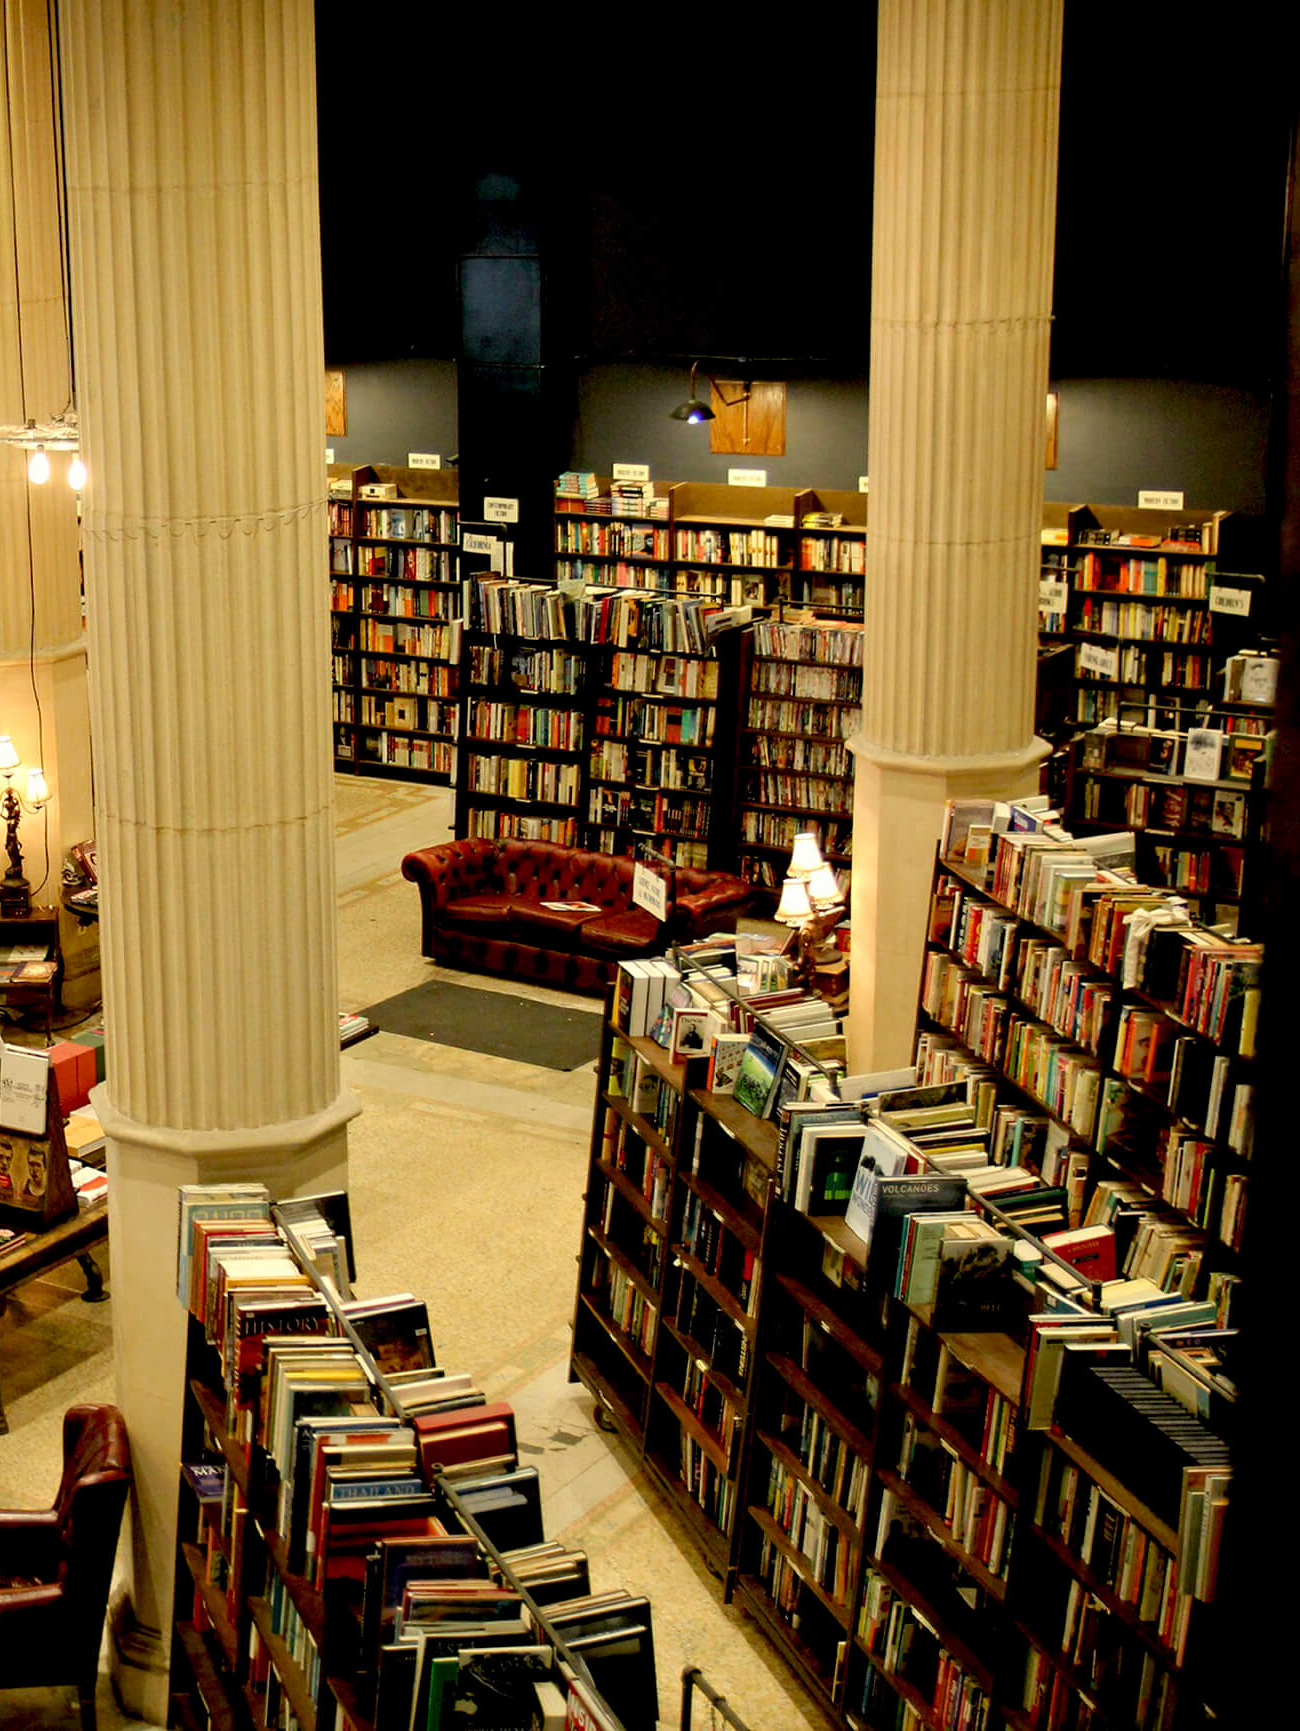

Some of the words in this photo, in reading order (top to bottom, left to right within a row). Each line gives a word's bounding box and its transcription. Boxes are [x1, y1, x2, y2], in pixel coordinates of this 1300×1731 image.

[882, 1184, 940, 1194] VOLCANOES
[244, 1315, 324, 1336] HISTORY
[338, 1484, 416, 1498] THAILAND
